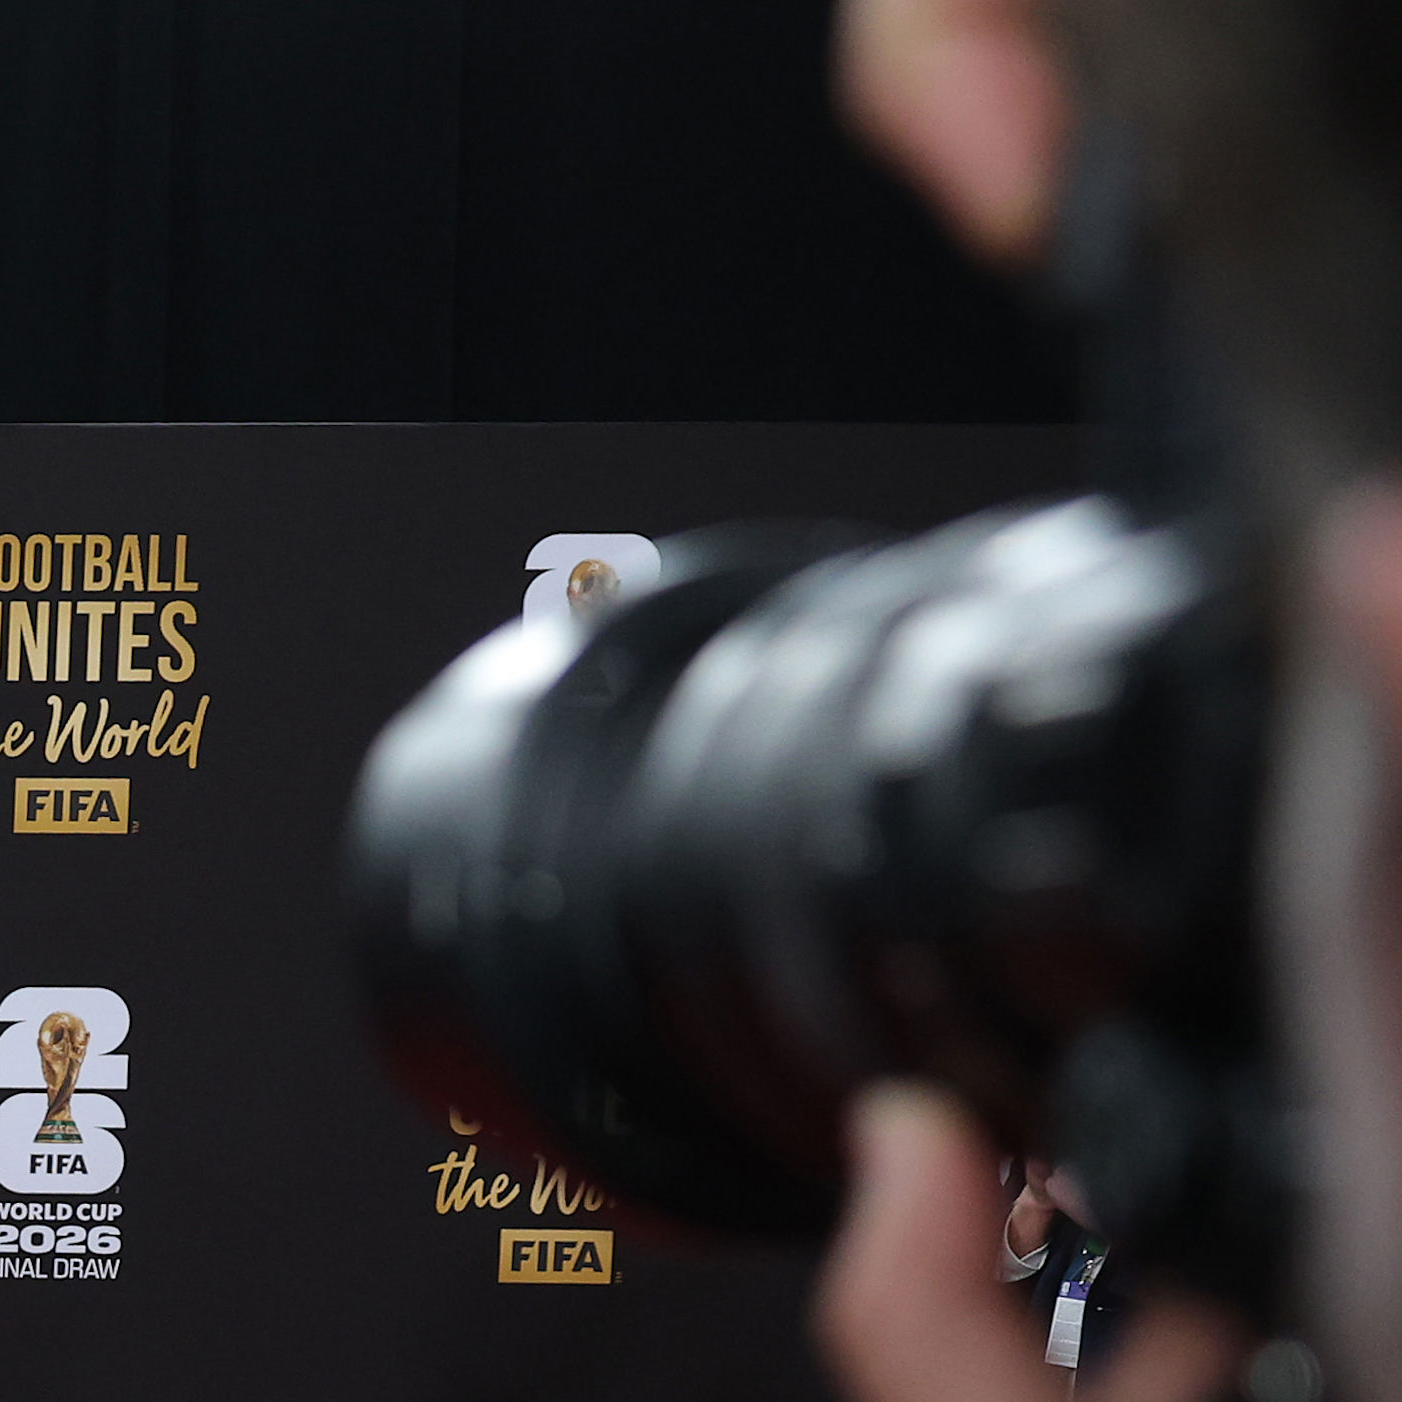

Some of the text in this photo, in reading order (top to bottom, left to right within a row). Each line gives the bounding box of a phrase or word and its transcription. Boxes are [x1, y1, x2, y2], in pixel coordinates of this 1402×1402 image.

[45, 690, 210, 768] World
[27, 790, 120, 822] FIFA
[30, 1154, 87, 1174] FIFA
[428, 1144, 521, 1215] the
[77, 1204, 122, 1221] CUP
[54, 1258, 120, 1279] DRAW
[511, 1240, 603, 1273] FIFA
